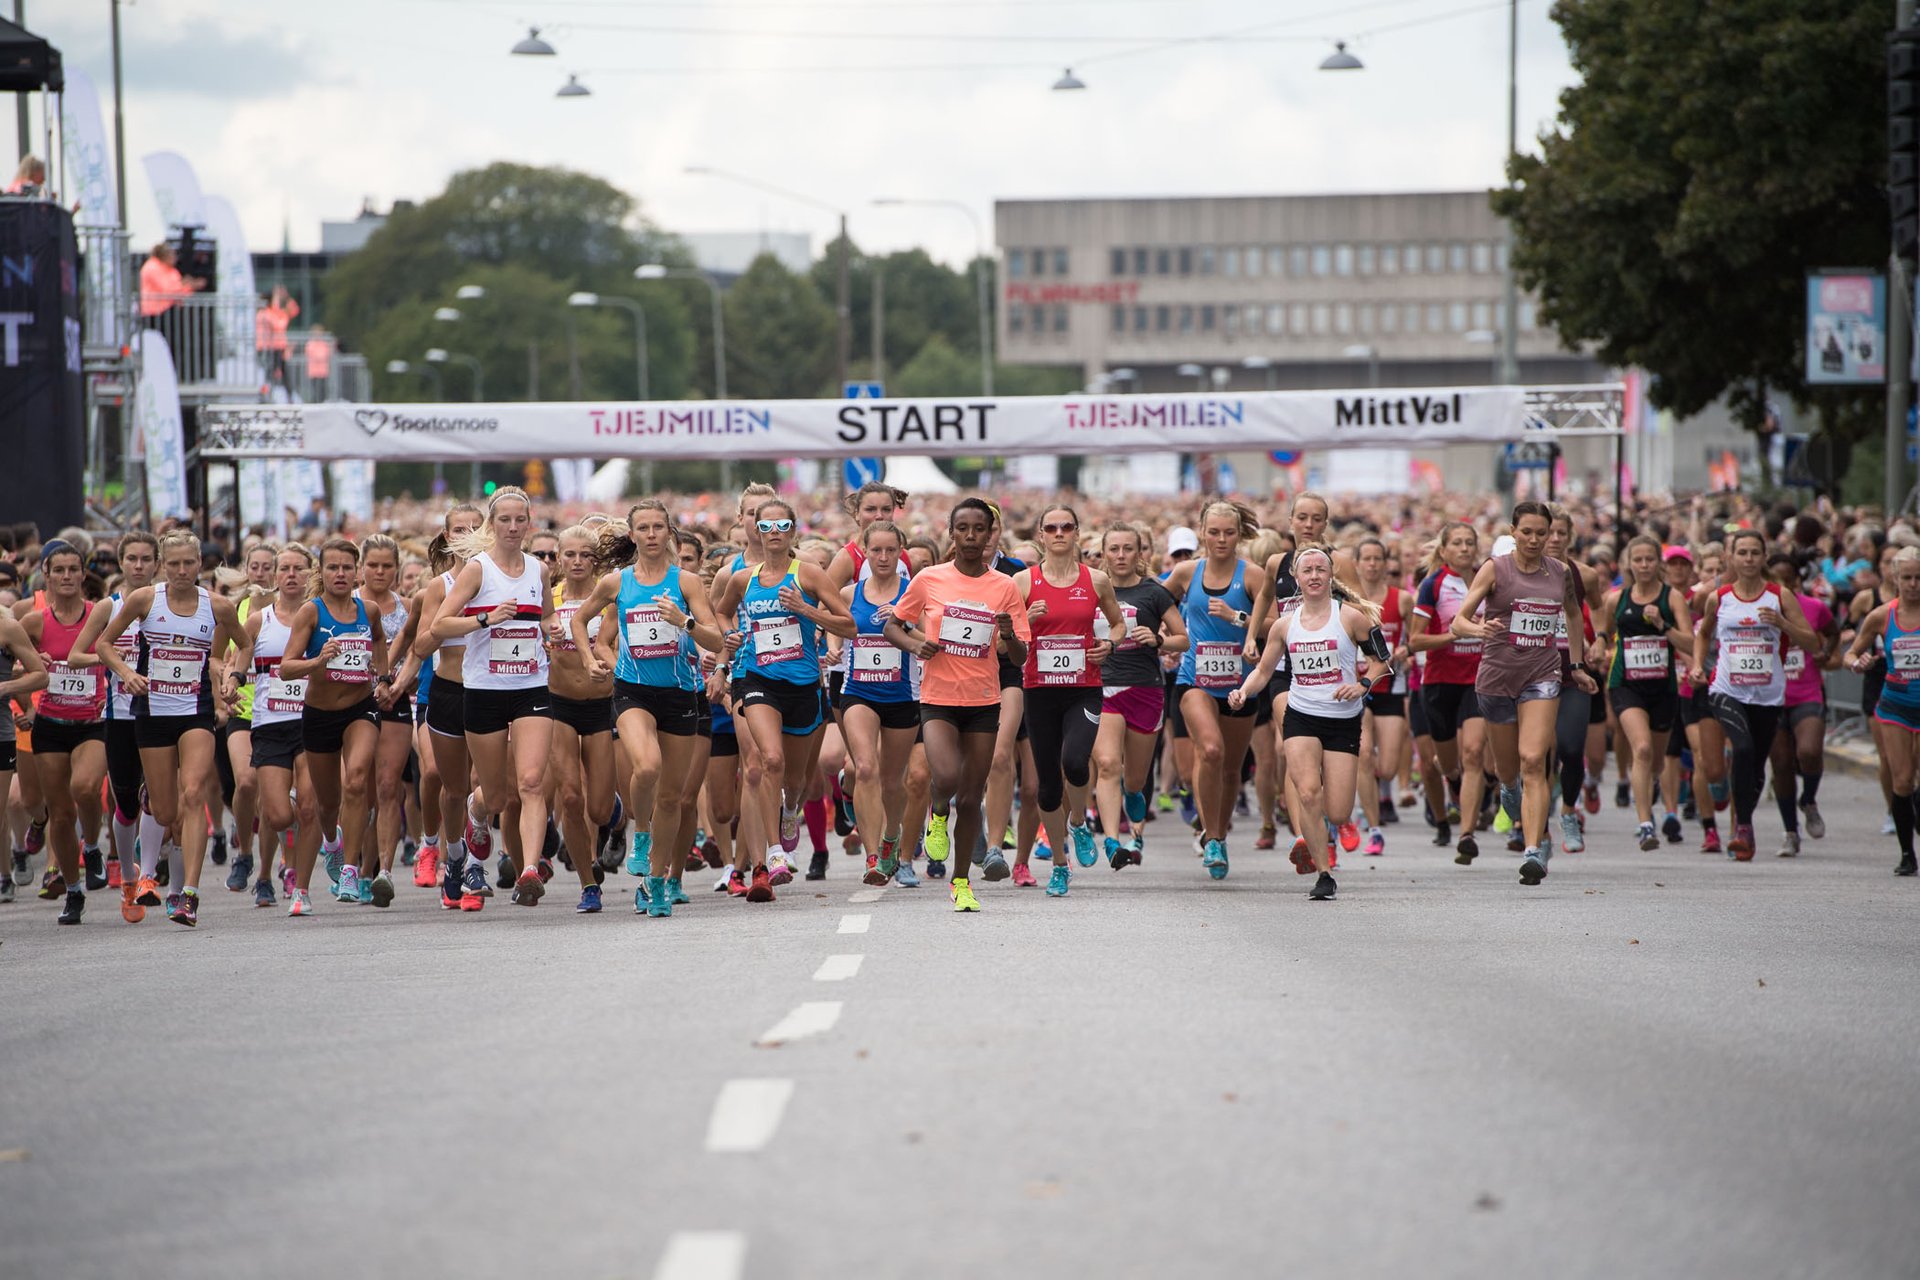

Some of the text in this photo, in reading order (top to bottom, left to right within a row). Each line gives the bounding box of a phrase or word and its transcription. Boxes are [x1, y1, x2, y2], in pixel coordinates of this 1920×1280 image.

[393, 383, 1460, 443] Sportamore TJEJMILEN START TJEJMILEN MittVal
[746, 599, 781, 615] HOKA
[960, 611, 992, 622] Sportamore
[1521, 618, 1550, 630] 1109
[650, 628, 658, 640] 3
[962, 626, 972, 640] 2
[772, 634, 782, 646] 5
[1516, 636, 1546, 647] MittVal
[512, 644, 520, 657] 4
[944, 644, 980, 658] MittVal
[1202, 646, 1234, 656] MittVal
[1296, 641, 1328, 653] MittVal
[344, 654, 360, 666] 25
[872, 652, 882, 666] 6
[1053, 656, 1070, 668] 20
[1300, 656, 1331, 670] 1241
[1634, 652, 1661, 664] 1110
[1740, 658, 1764, 670] 323
[173, 666, 182, 678] 8
[496, 664, 530, 674] MittVal
[1204, 660, 1235, 672] 1313
[860, 672, 892, 682] MittVal
[1044, 675, 1077, 684] MittVal
[60, 680, 84, 692] 179
[158, 684, 192, 694] MittVal
[285, 684, 301, 696] 38
[274, 702, 304, 712] MittVa
